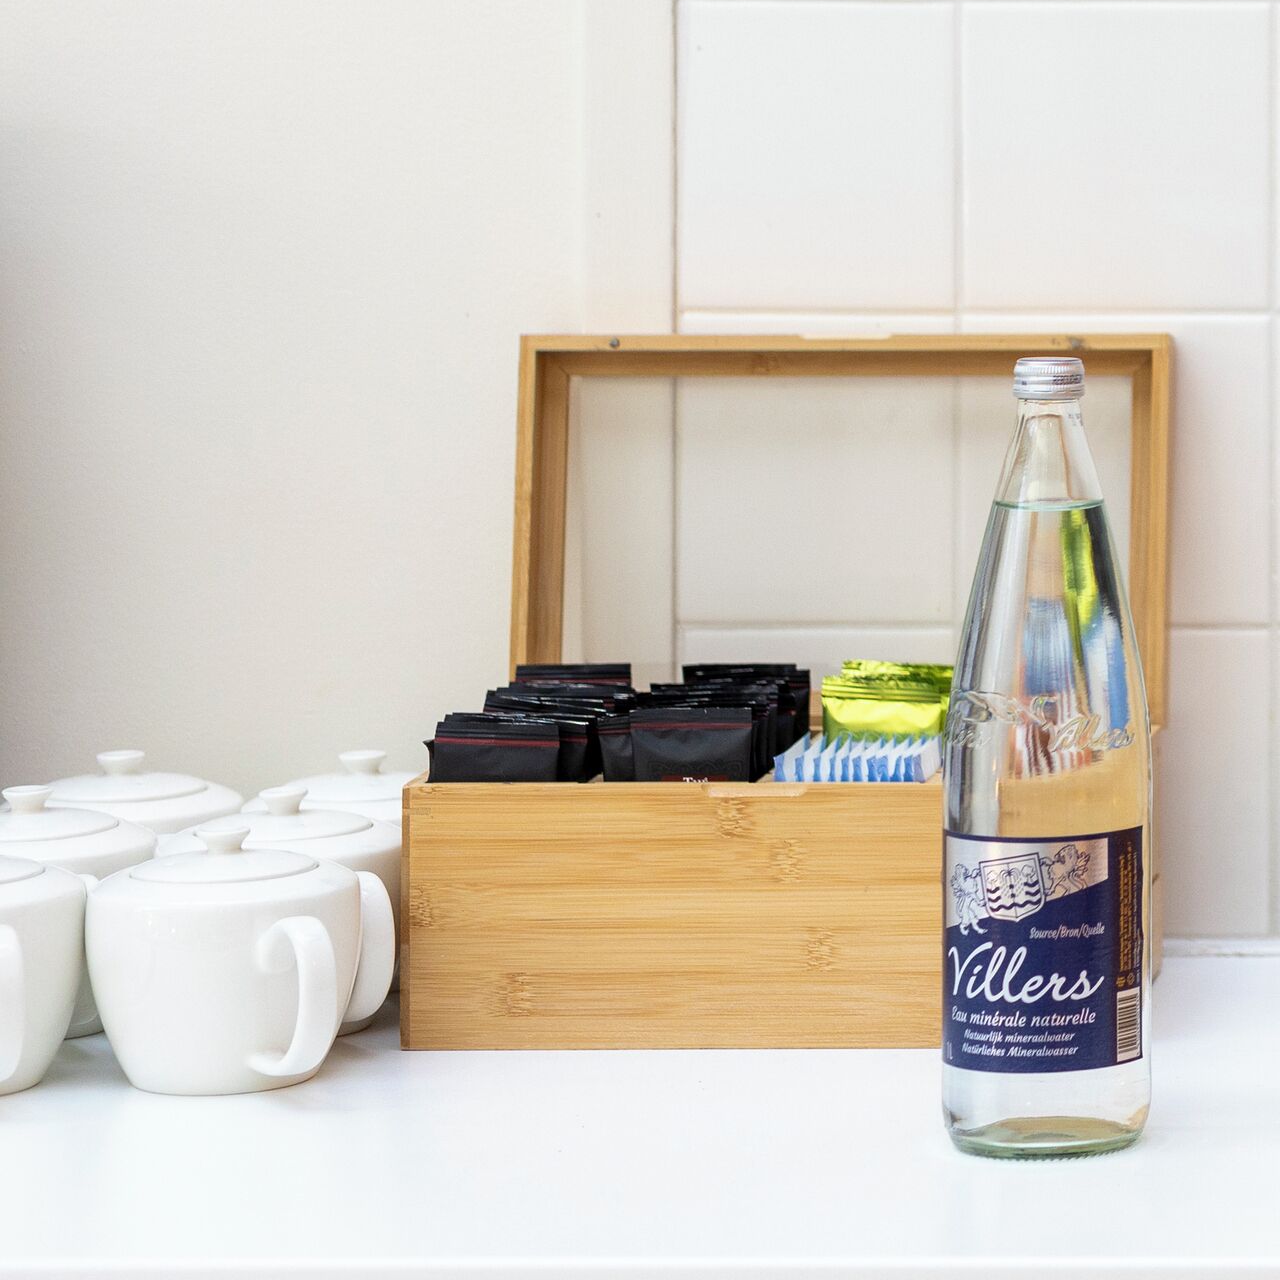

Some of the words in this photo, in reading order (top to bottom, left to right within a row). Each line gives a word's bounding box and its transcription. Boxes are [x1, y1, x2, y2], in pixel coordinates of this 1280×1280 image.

[1029, 923, 1105, 940] Source/Bron/Quelle
[948, 941, 1105, 1003] Villers
[951, 1006, 967, 1021] Eau
[970, 1009, 1027, 1027] minérale
[1030, 1007, 1096, 1028] naturelle
[963, 1028, 1003, 1045] Natuurlijk
[1005, 1030, 1076, 1043] mineraalwater
[961, 1042, 1006, 1057] Natürliches
[1007, 1045, 1079, 1057] Mineralwasser
